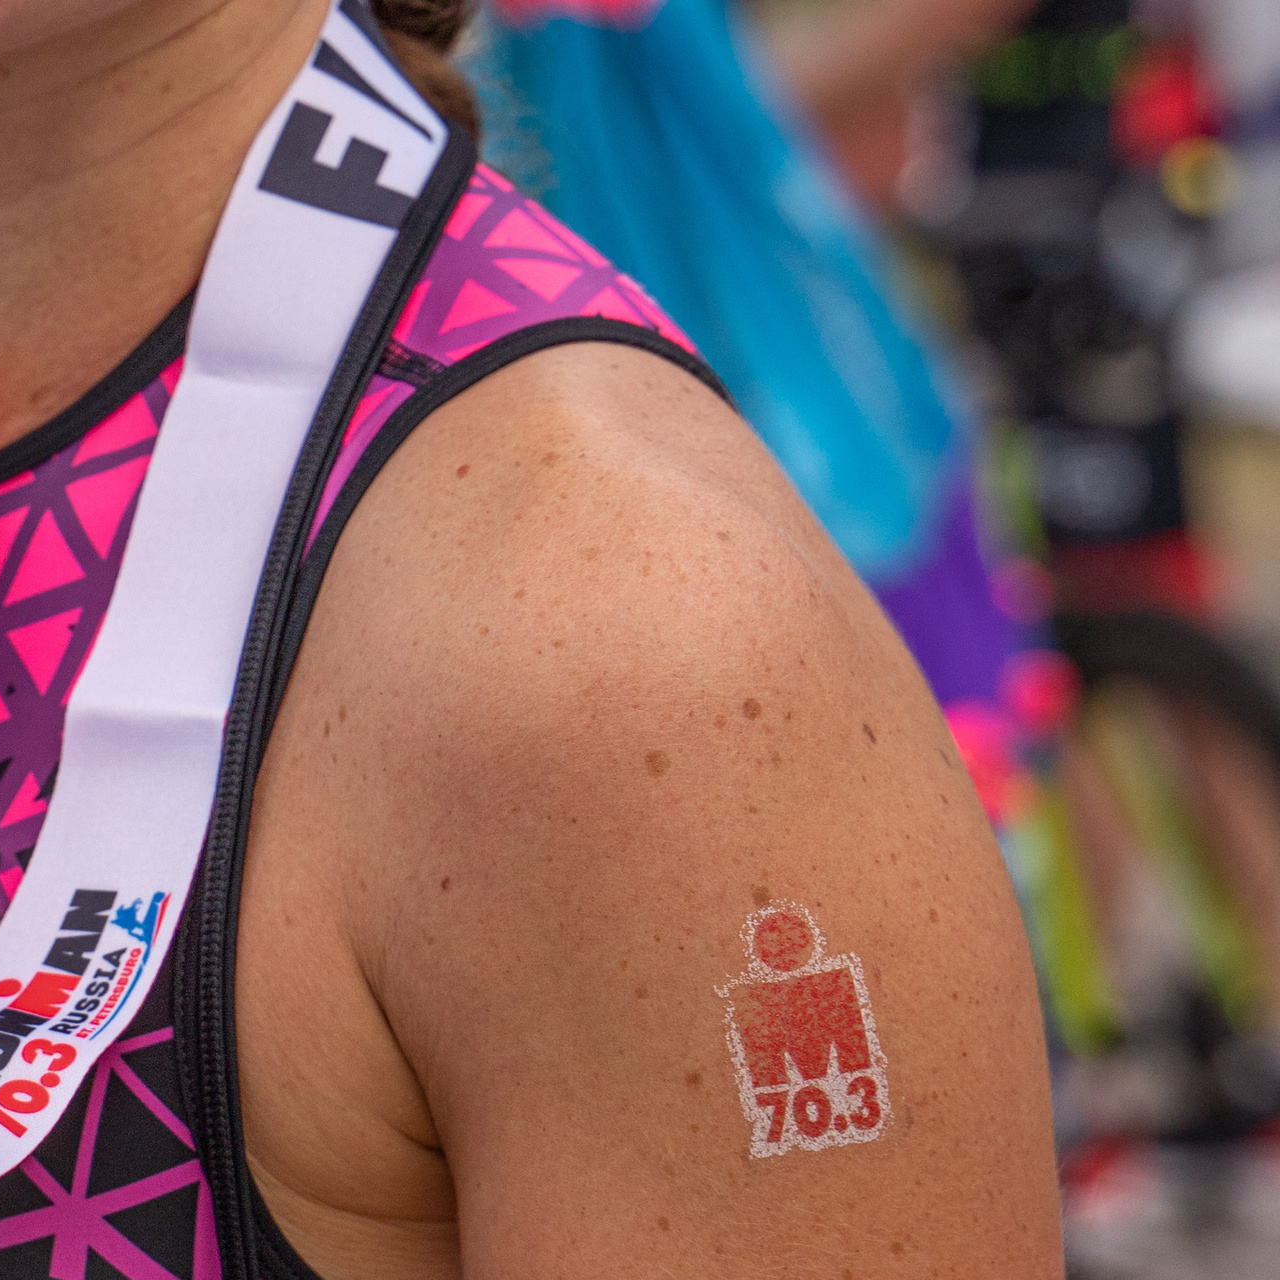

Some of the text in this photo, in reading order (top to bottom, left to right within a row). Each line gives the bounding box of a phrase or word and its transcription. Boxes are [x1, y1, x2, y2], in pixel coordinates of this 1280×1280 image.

[48, 947, 128, 1035] RUSSIA
[91, 947, 142, 1027] PETERSBURG
[754, 1075, 882, 1144] 70.3
